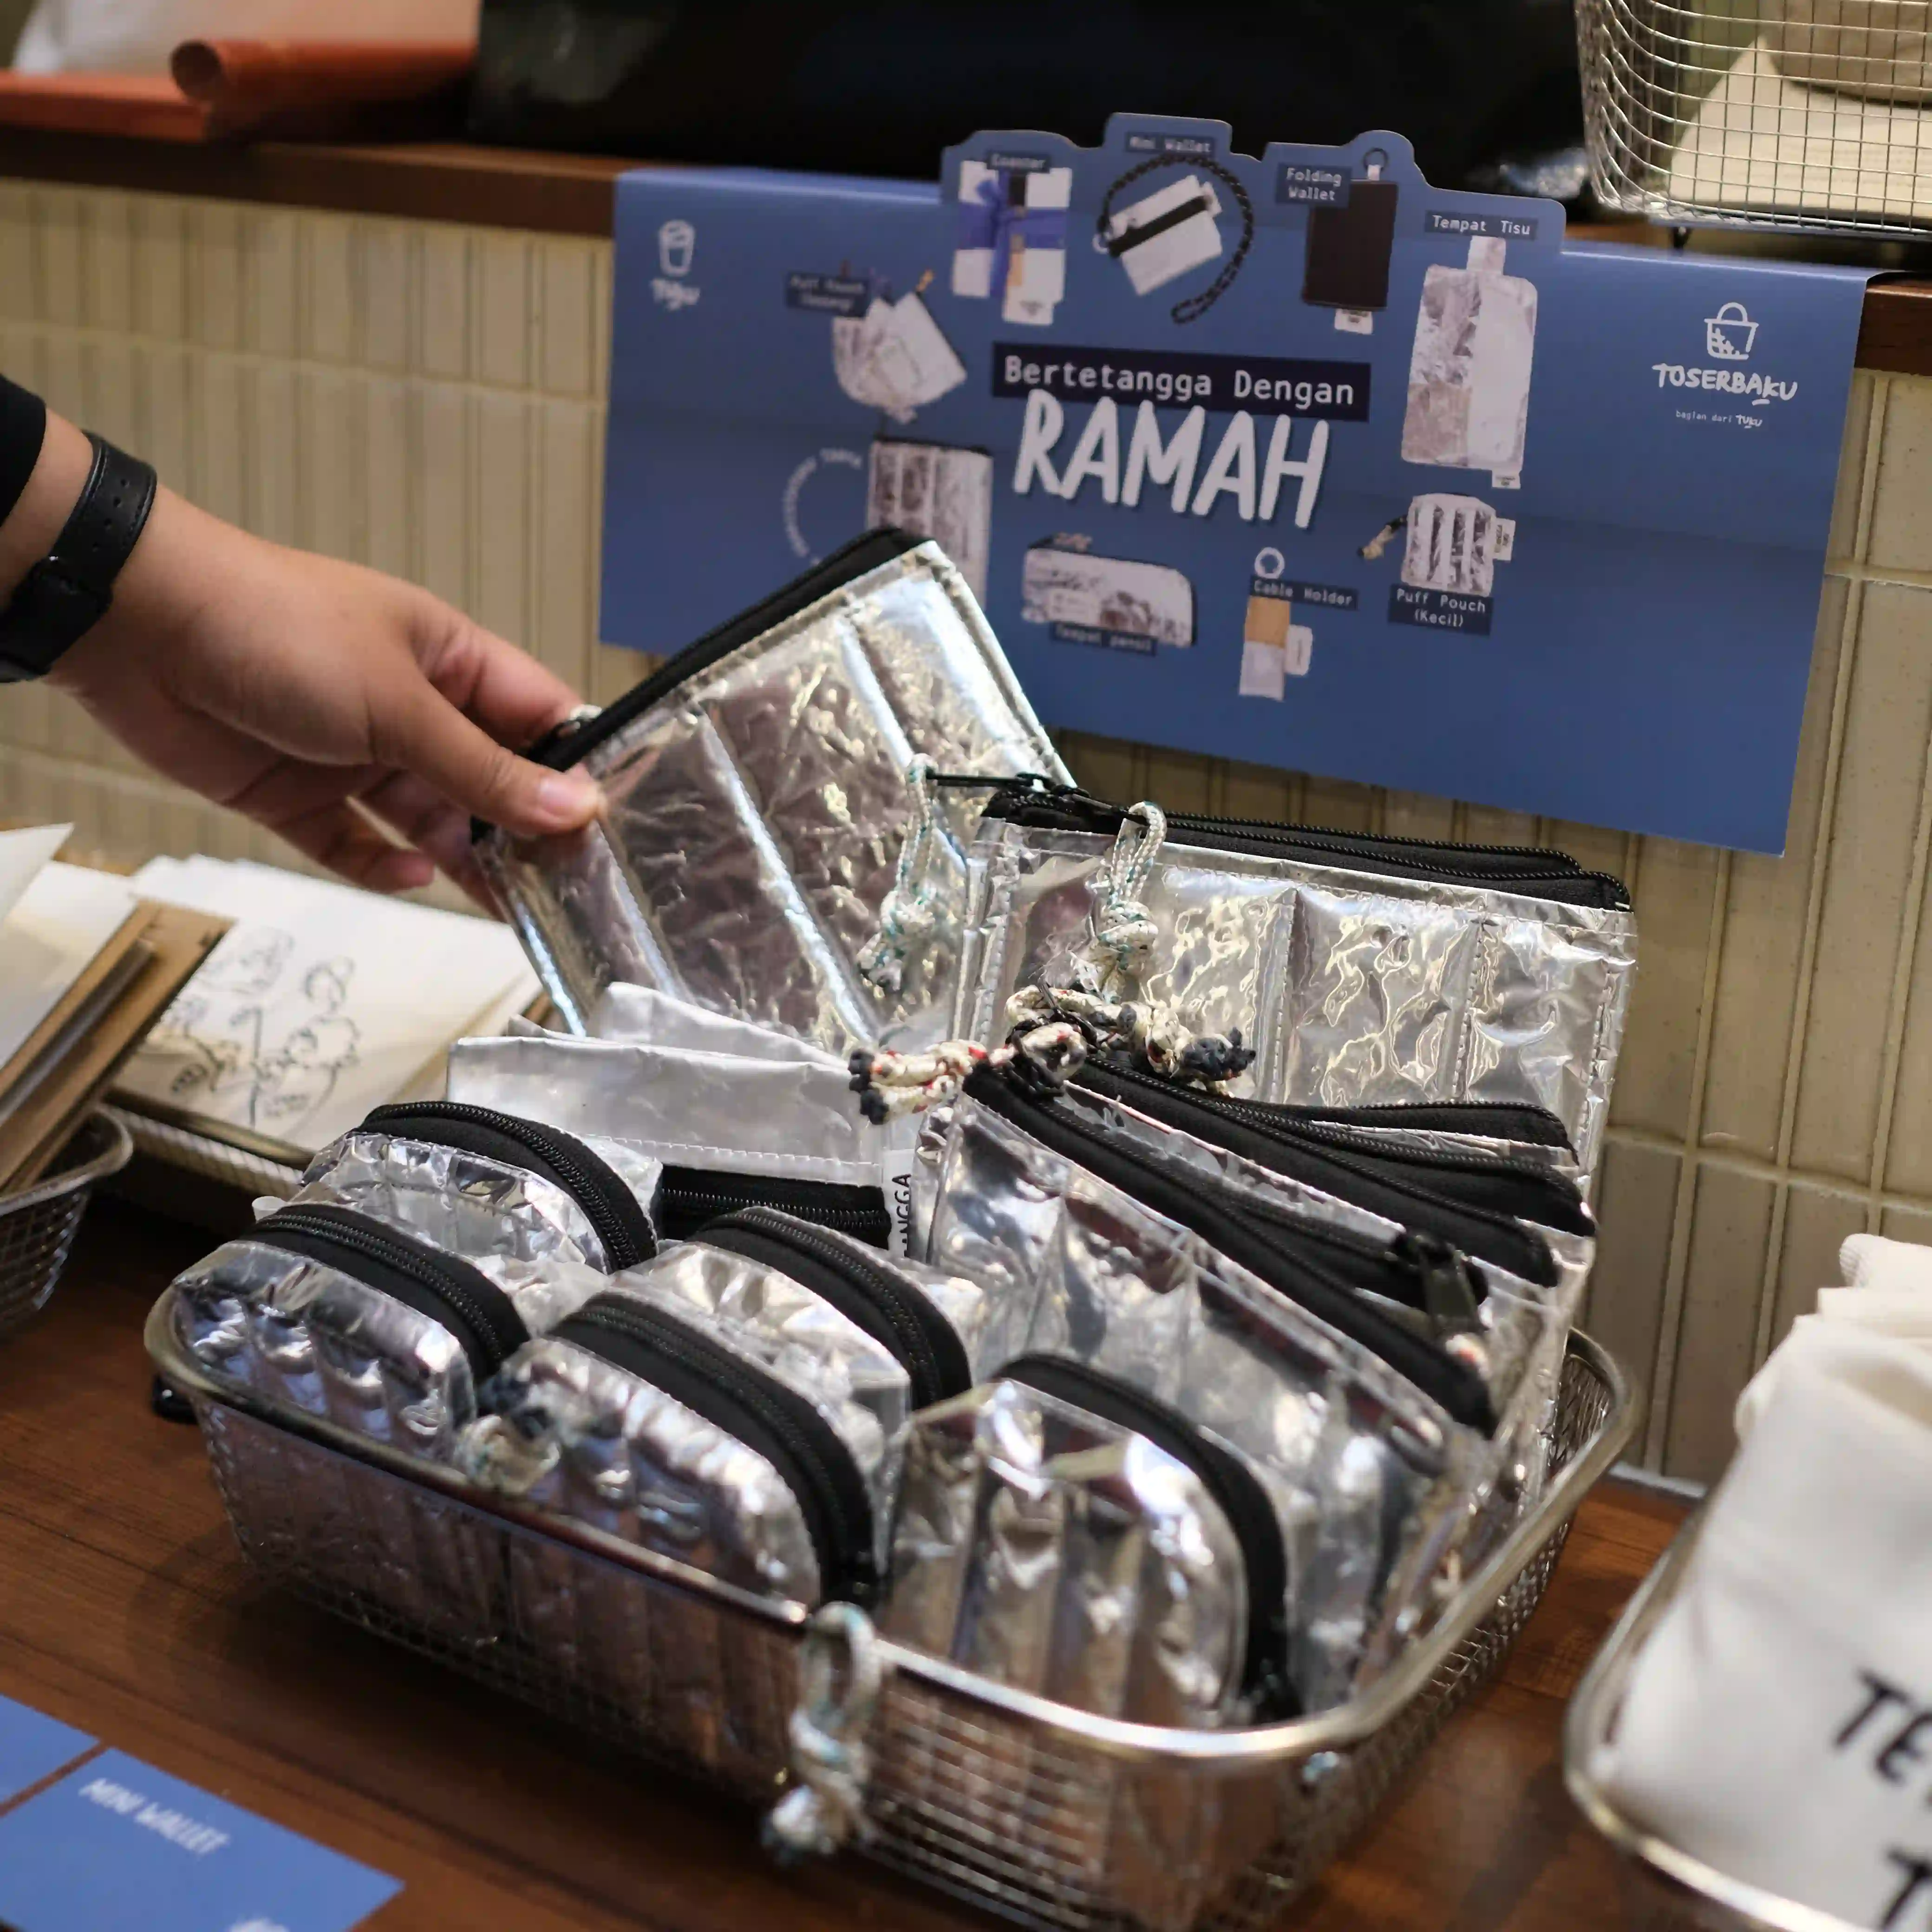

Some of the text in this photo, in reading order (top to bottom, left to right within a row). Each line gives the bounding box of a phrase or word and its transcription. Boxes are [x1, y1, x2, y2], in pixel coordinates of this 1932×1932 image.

[1286, 167, 1342, 188] Folding
[1288, 186, 1336, 201] Wallet
[1432, 214, 1531, 235] Tempat Tisu
[1004, 354, 1354, 410] Bertetangga Dengan
[1651, 362, 1798, 404] TOSERBAKU
[1675, 409, 1707, 422] bagian
[1711, 414, 1733, 424] dari
[1012, 389, 1330, 529] RAMAH
[1304, 587, 1353, 606] Holder
[1396, 587, 1486, 613] Puff Pouch
[1414, 608, 1464, 627] (Kecil)
[891, 1173, 912, 1258] NGGA
[1833, 1666, 1932, 1807] TE
